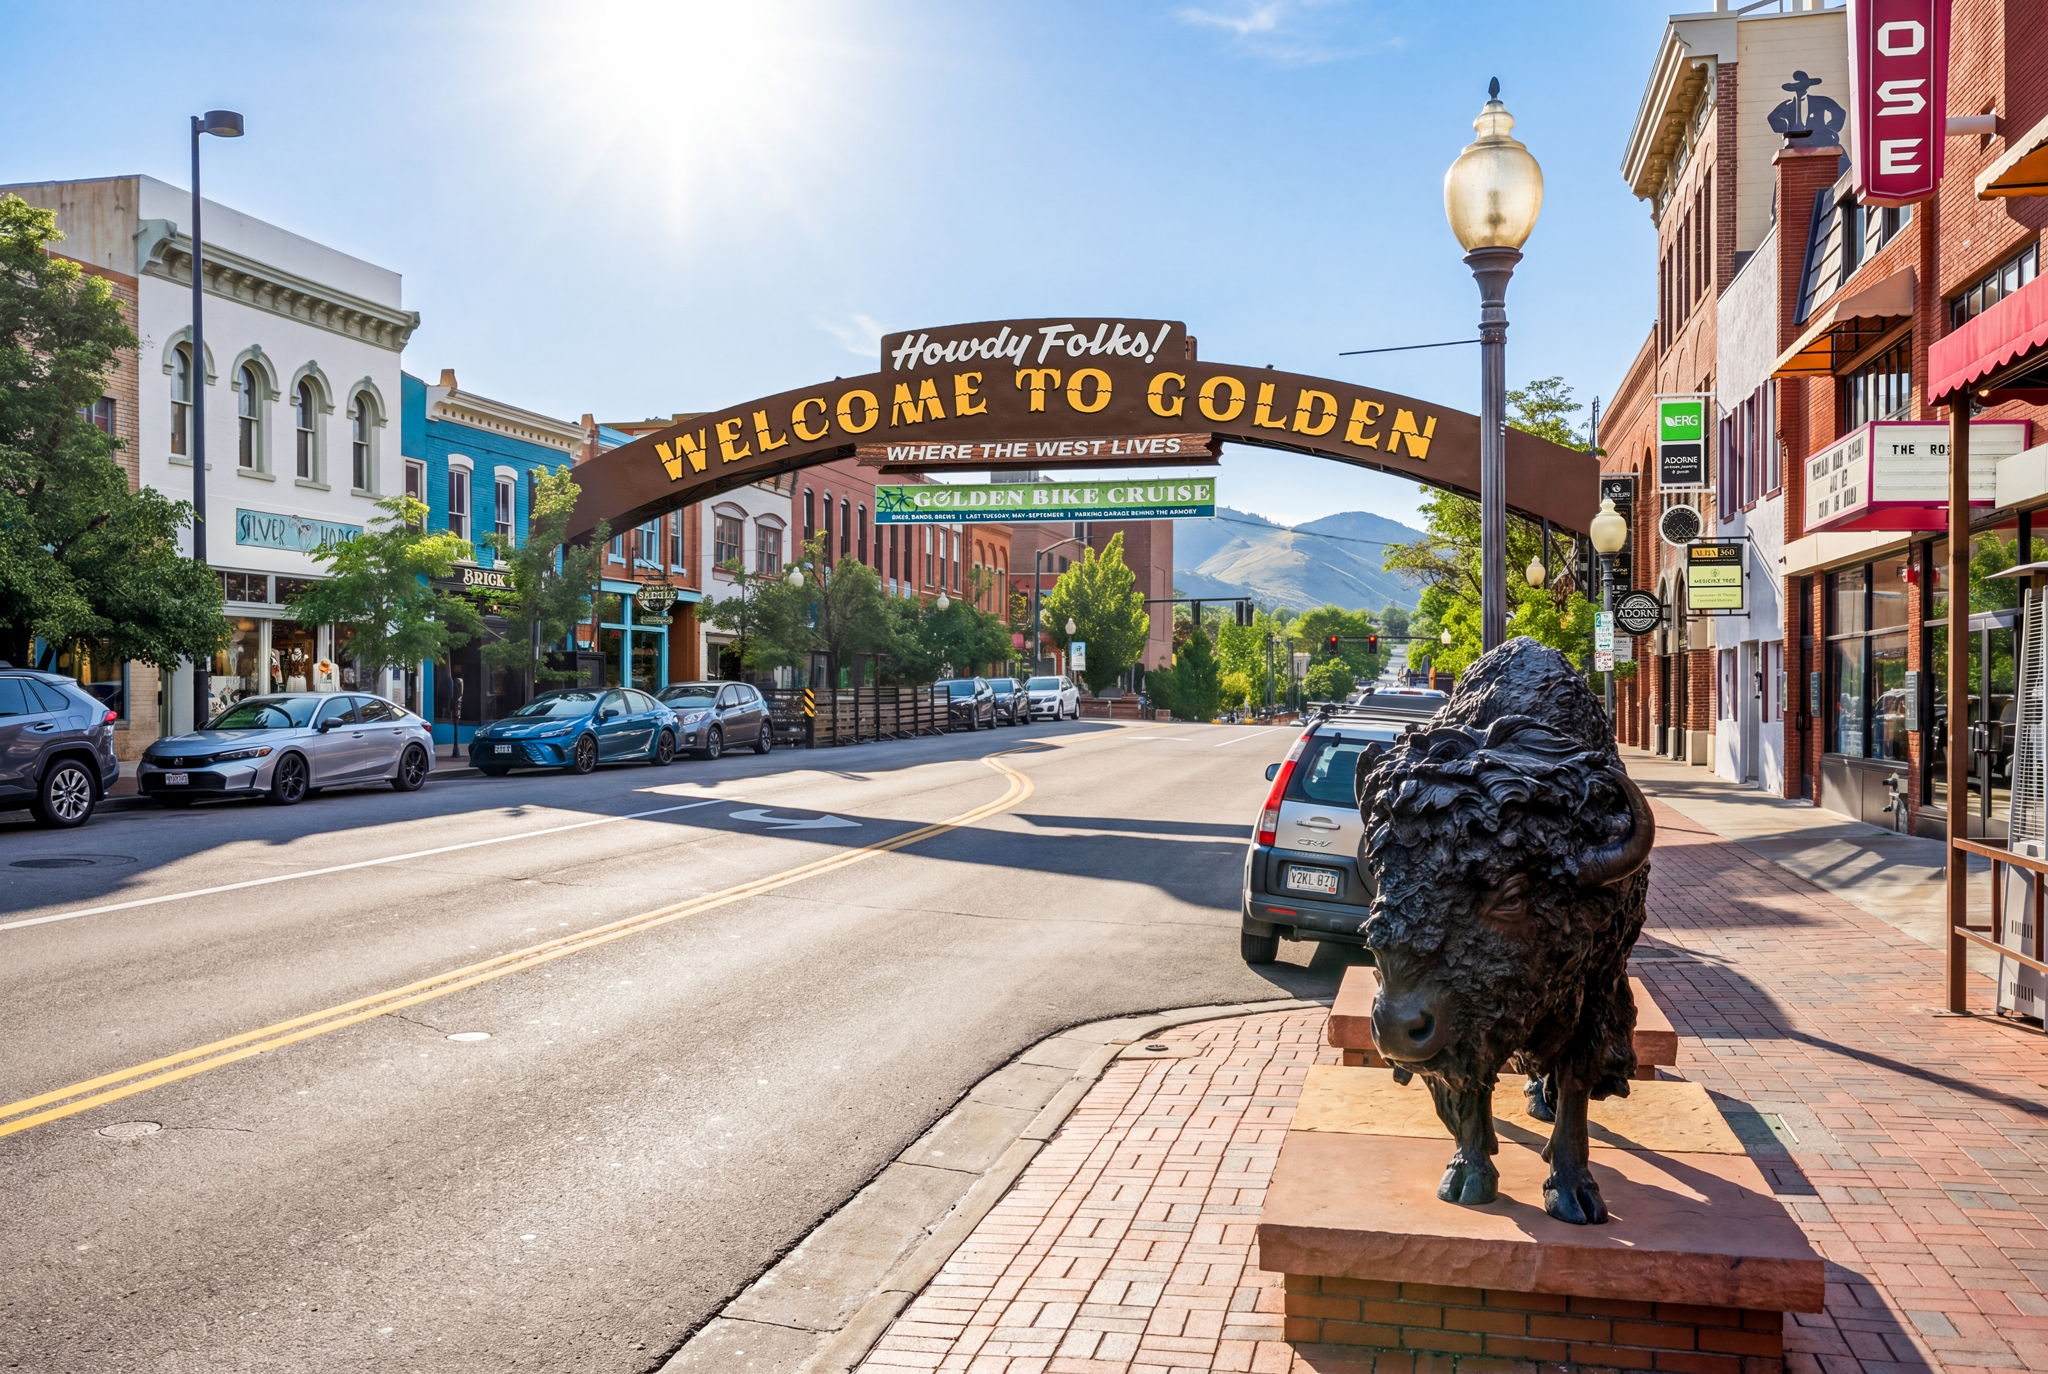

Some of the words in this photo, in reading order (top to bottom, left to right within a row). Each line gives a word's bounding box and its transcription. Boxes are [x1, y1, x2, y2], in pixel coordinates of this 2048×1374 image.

[891, 325, 1032, 370] Howdy
[1037, 323, 1171, 364] Folks!
[654, 371, 988, 482] WELCOME
[1015, 367, 1113, 413] TO
[1147, 371, 1437, 460] GOLDEN
[1674, 415, 1698, 426] ERG
[887, 444, 973, 461] WHERE
[980, 442, 1031, 458] THE
[1035, 440, 1105, 456] WEST
[1110, 438, 1181, 455] LIVES
[1892, 444, 1915, 455] THE
[1664, 456, 1698, 464] ADORNE
[913, 489, 1025, 507] GOLDEN
[1032, 488, 1099, 505] BIKE
[1107, 484, 1210, 504] CRUISE
[1719, 548, 1735, 556] 360
[463, 568, 506, 587] BRICK
[1617, 609, 1659, 618] ADORNE
